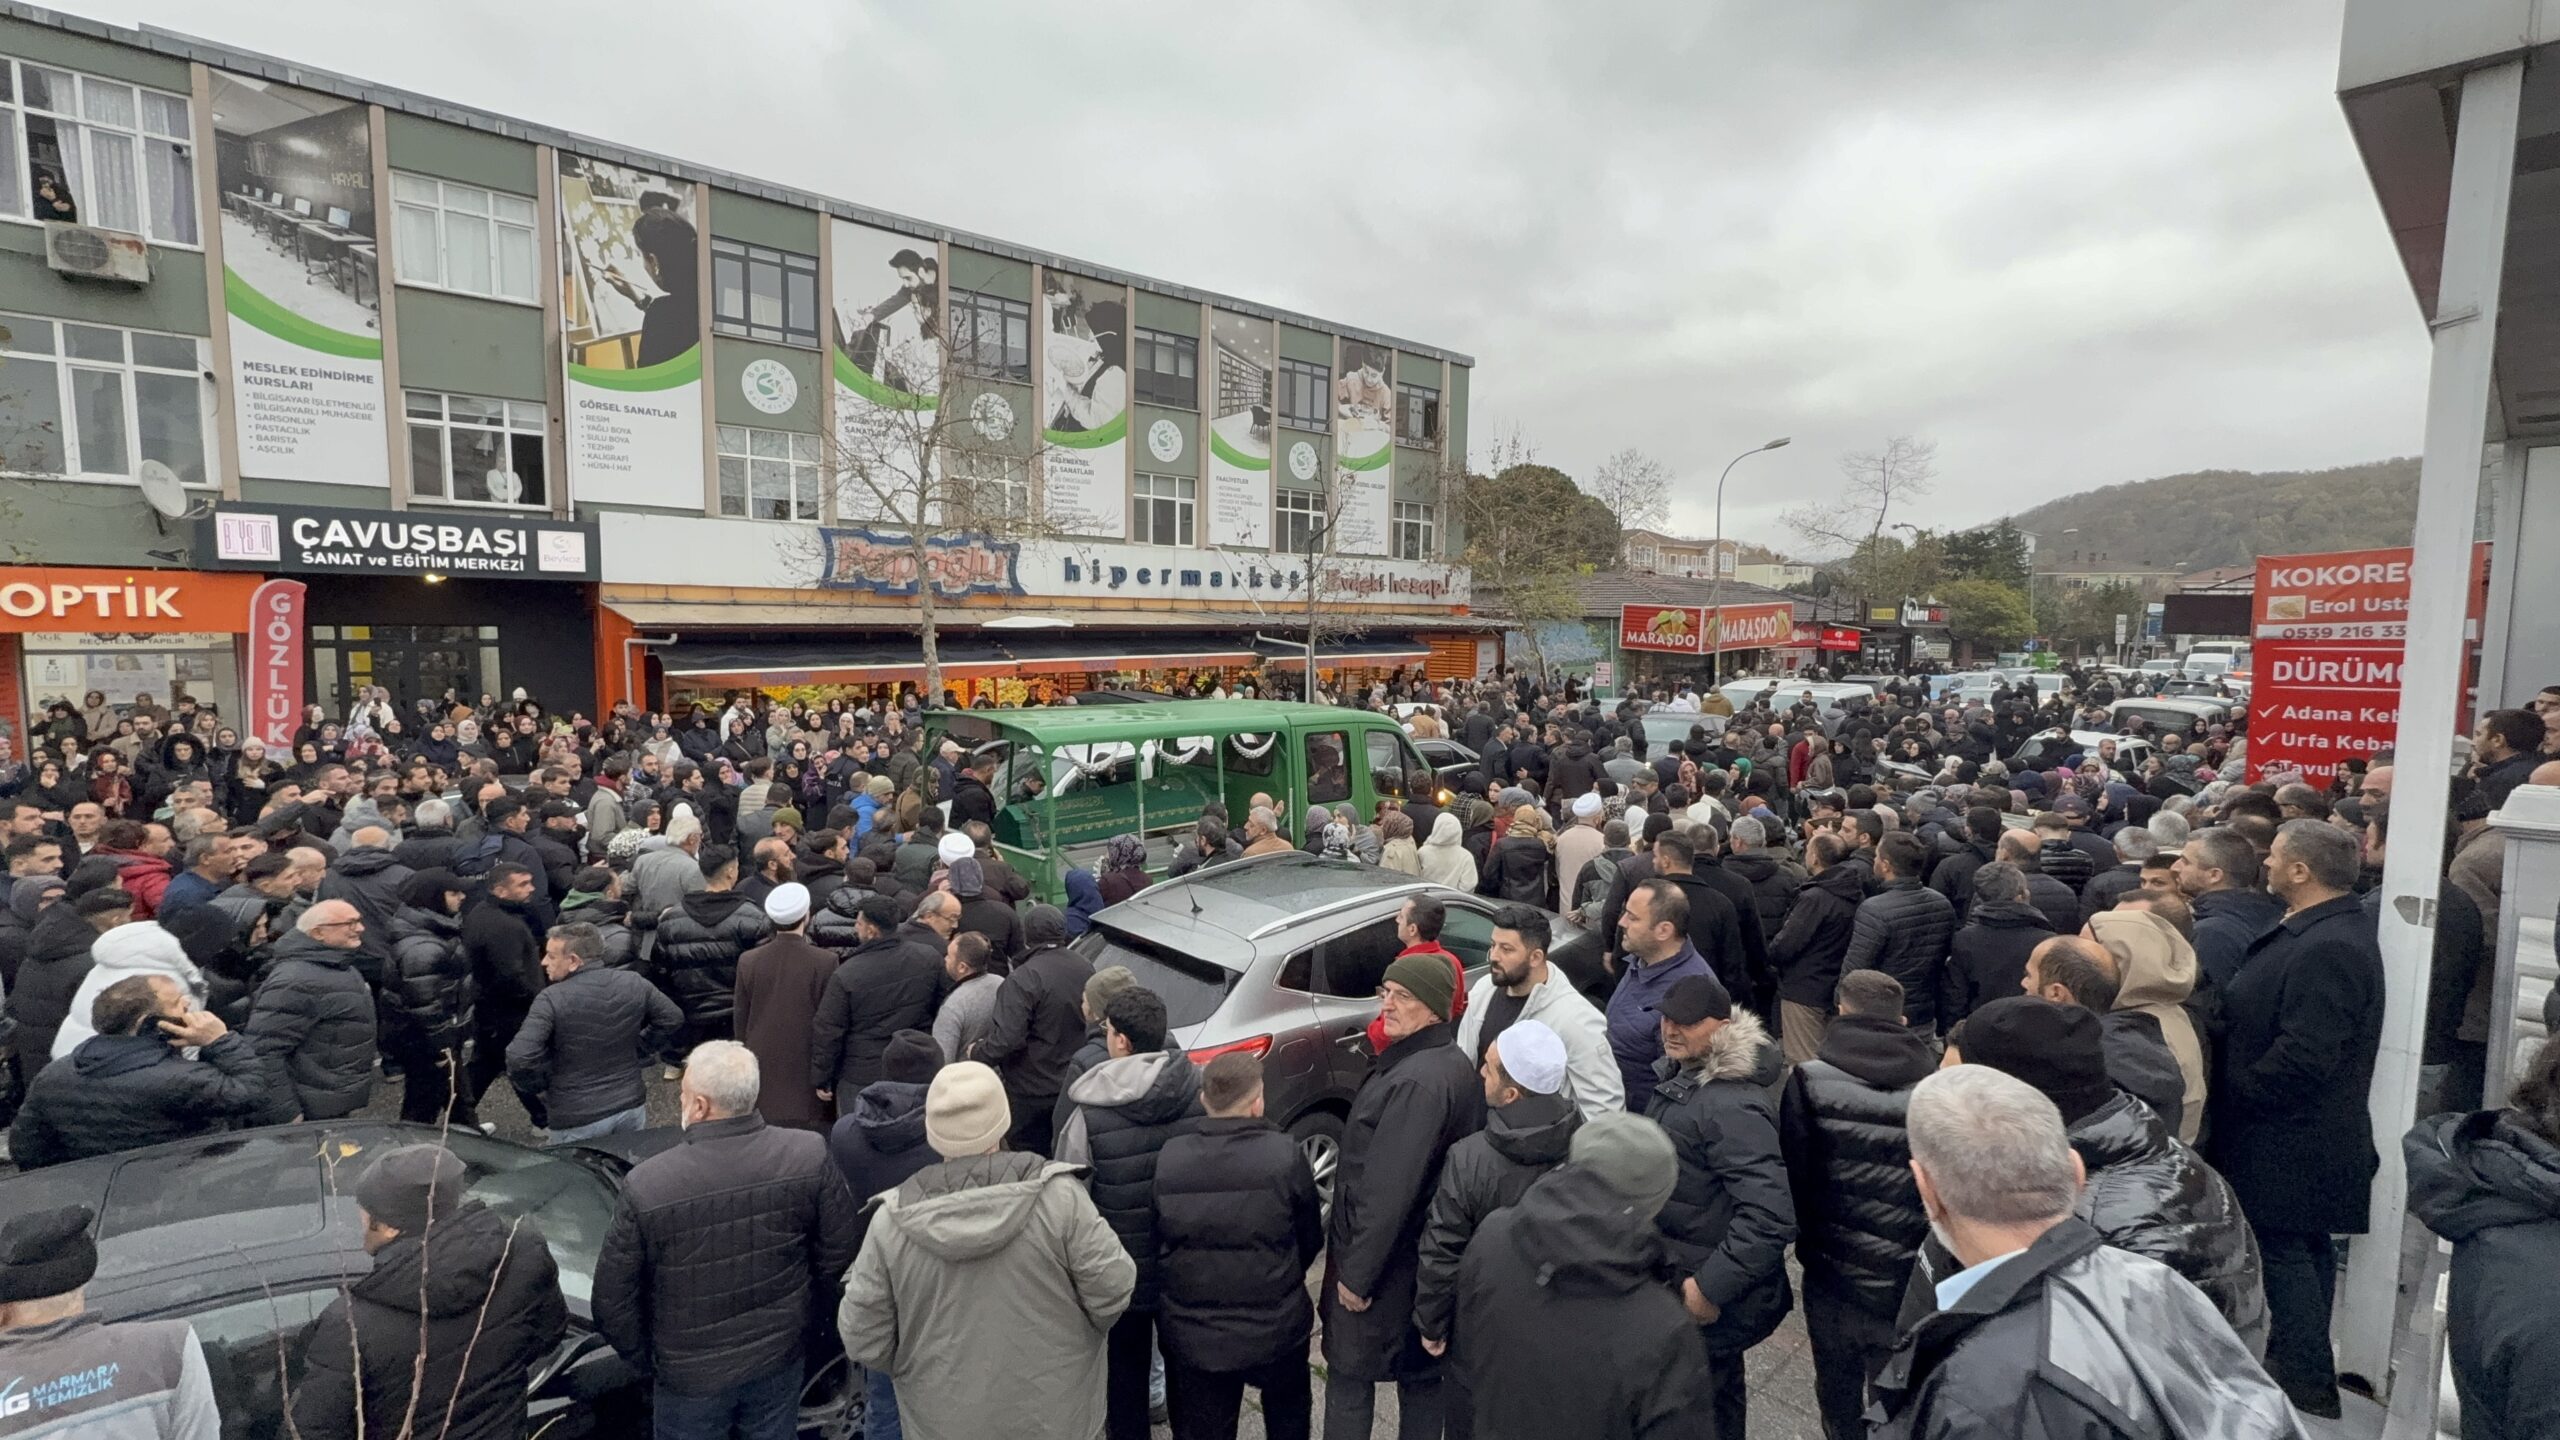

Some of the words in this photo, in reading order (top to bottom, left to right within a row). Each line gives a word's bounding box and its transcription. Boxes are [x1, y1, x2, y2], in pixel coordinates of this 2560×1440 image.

[243, 361, 298, 376] MESLEK
[301, 367, 375, 384] EDİNDİRME
[244, 375, 313, 391] KURSLARI
[252, 391, 311, 405] BİLGİSAYAR
[253, 402, 319, 416] BİLGİSAYARLI
[321, 409, 373, 421] MUHASEBE
[579, 399, 621, 412] GÖRSEL
[623, 405, 677, 419] SANATLAR
[254, 413, 317, 426] GARSONLUK
[255, 424, 310, 435] PASTACILIK
[610, 426, 632, 435] BOYA
[256, 434, 298, 444] BARİSTA
[586, 433, 607, 442] SULU
[608, 436, 630, 444] BOYA
[257, 444, 295, 455] AŞÇILIK
[616, 464, 632, 472] HAT
[292, 517, 527, 557] ÇAVUŞBAŞI
[302, 551, 363, 566] SANAT
[368, 556, 387, 566] ve
[392, 553, 449, 569] EĞİTİM
[454, 557, 524, 571] MERKEZİ
[1063, 556, 1301, 590] hipermarket
[0, 576, 183, 617] OPTİK
[2309, 598, 2355, 614] Erol
[1719, 615, 1777, 643] MARAŞDO
[2282, 627, 2333, 639] 0539
[2340, 625, 2374, 638] 216
[2382, 624, 2406, 637] 33
[1626, 631, 1696, 648] MARAŞDO
[267, 592, 292, 744] GÖZLÜK
[2281, 705, 2353, 722] Adana
[2281, 732, 2329, 749] Urfa
[32, 1362, 119, 1398] MARMARA
